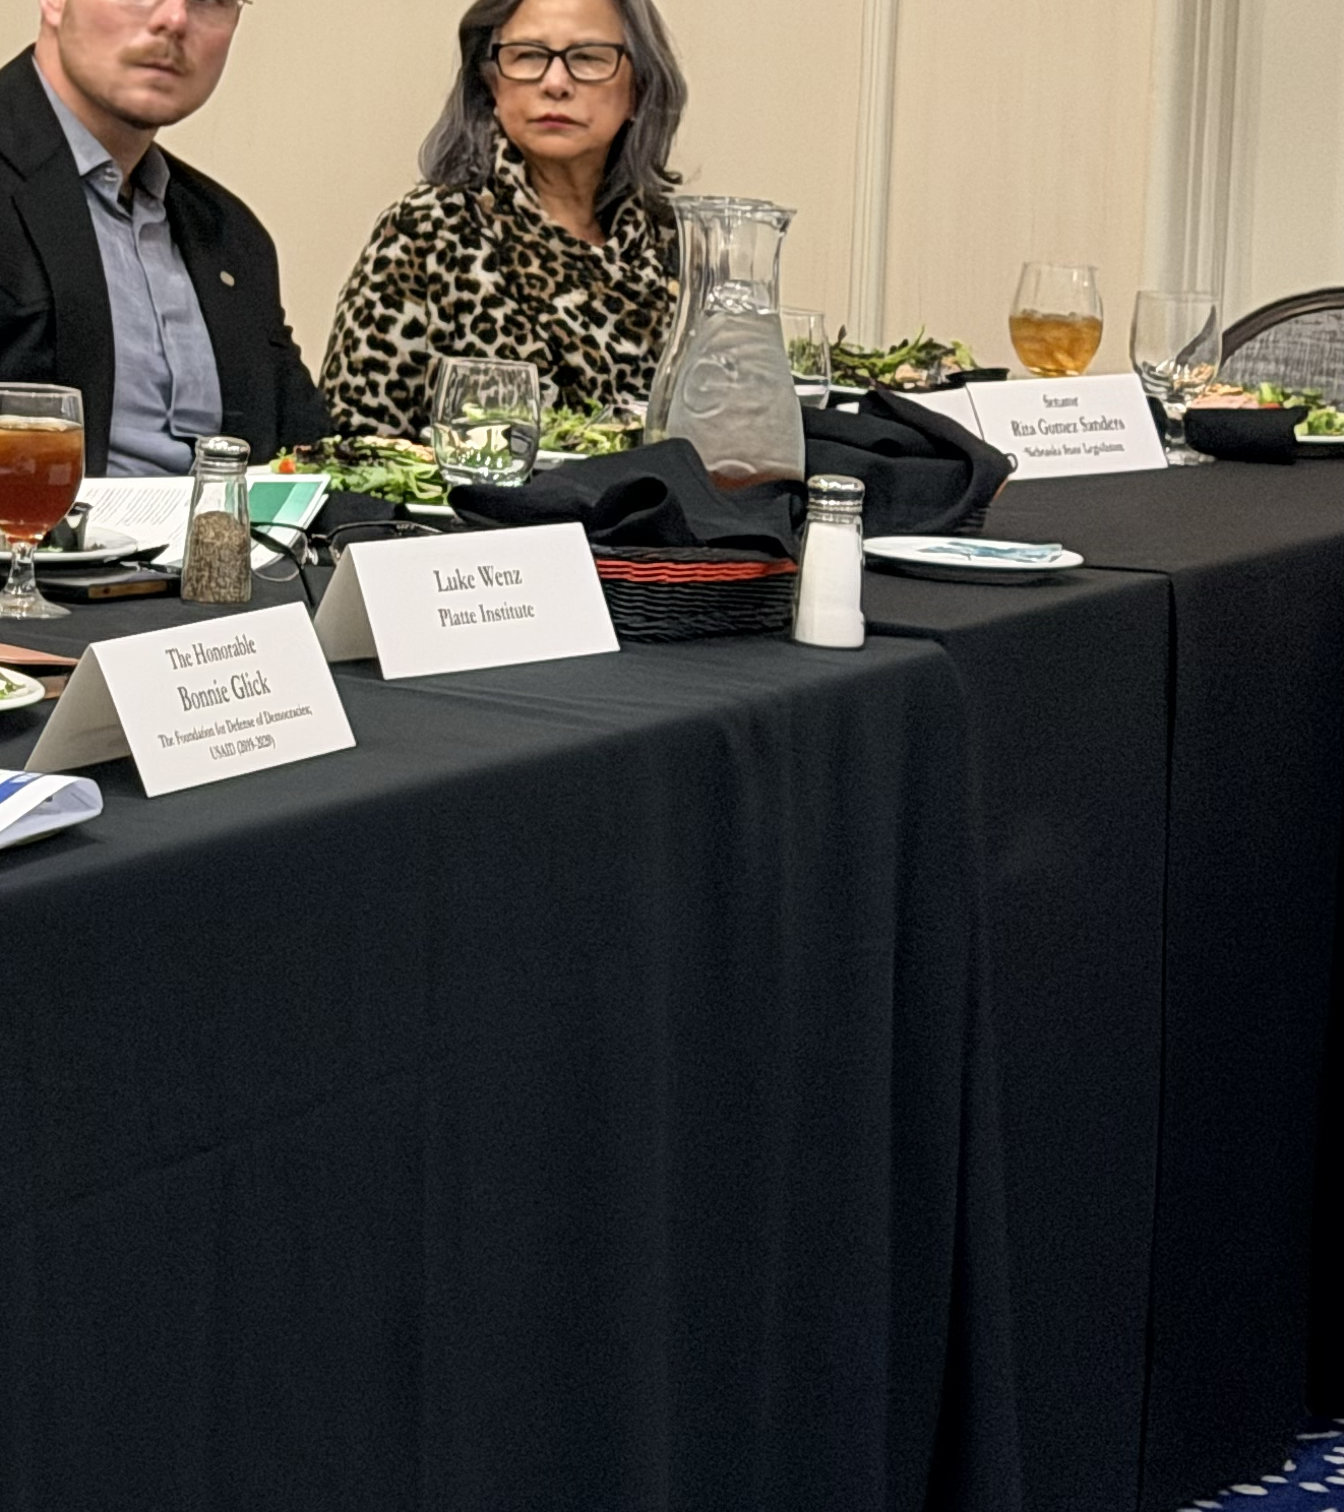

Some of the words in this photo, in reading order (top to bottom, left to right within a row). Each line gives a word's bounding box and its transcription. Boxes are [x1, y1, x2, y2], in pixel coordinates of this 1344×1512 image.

[432, 567, 476, 593] Luke
[476, 565, 524, 588] Wenz
[436, 607, 478, 628] Platte
[477, 600, 536, 624] Institute
[164, 646, 194, 671] The
[191, 633, 257, 666] Honorable
[176, 678, 231, 712] Bonnie
[230, 669, 272, 701] Glick
[157, 733, 175, 749] The
[174, 726, 216, 746] Foundation
[225, 716, 256, 735] Defense
